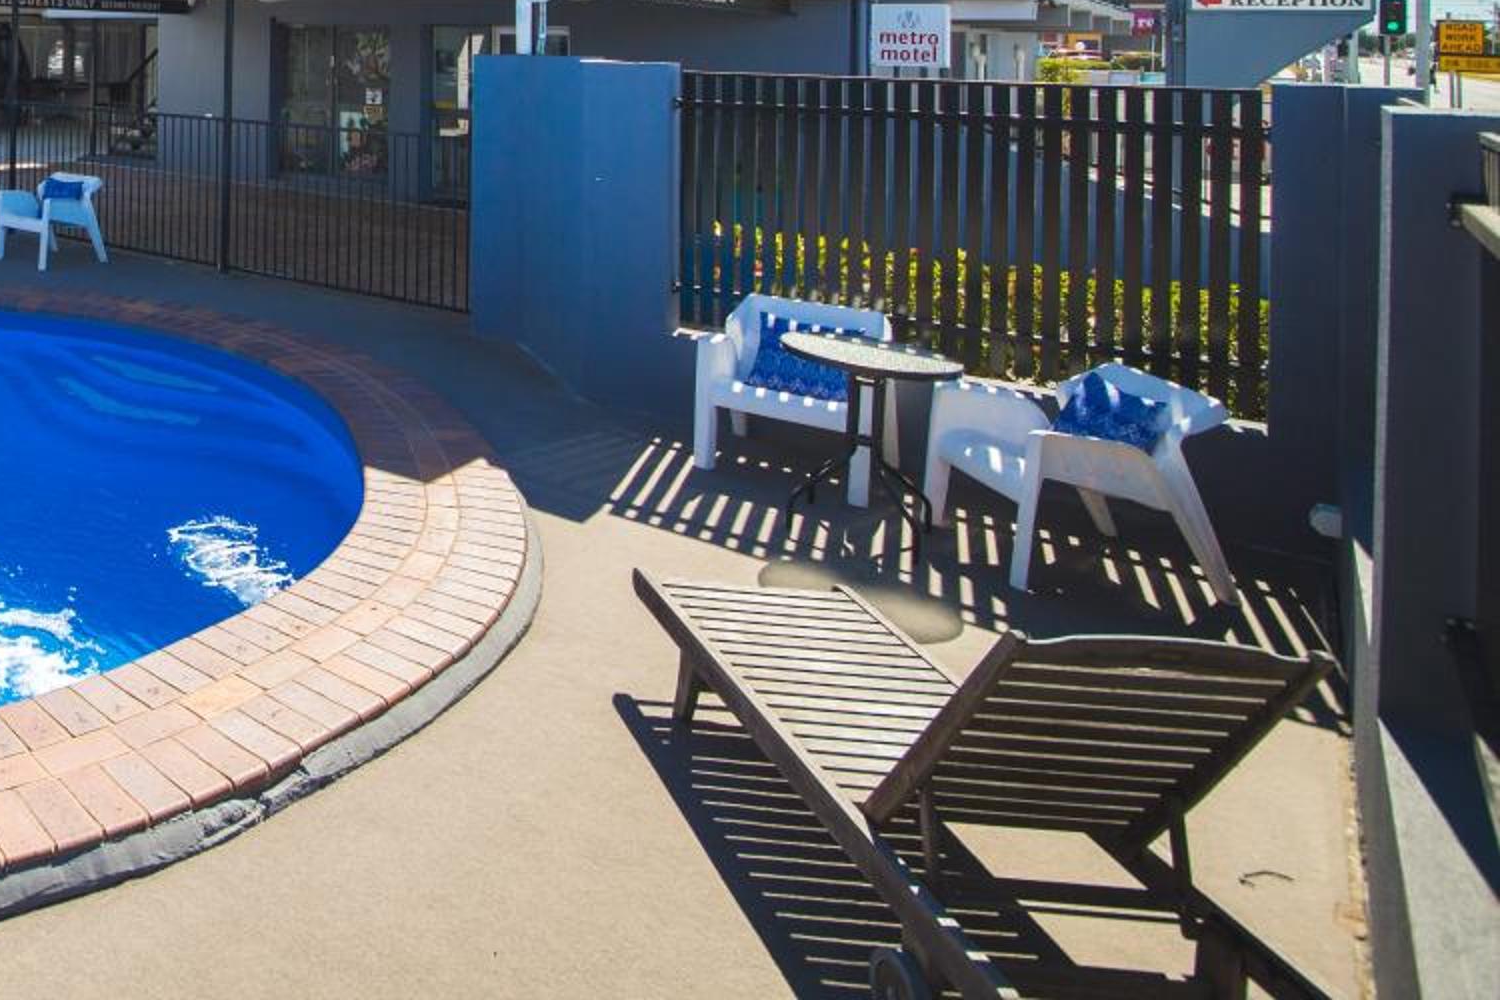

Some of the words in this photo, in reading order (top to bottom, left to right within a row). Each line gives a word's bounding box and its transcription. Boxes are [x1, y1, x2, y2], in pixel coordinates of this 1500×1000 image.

[1445, 23, 1477, 32] ROAD
[879, 31, 939, 45] metro
[881, 45, 937, 62] motel
